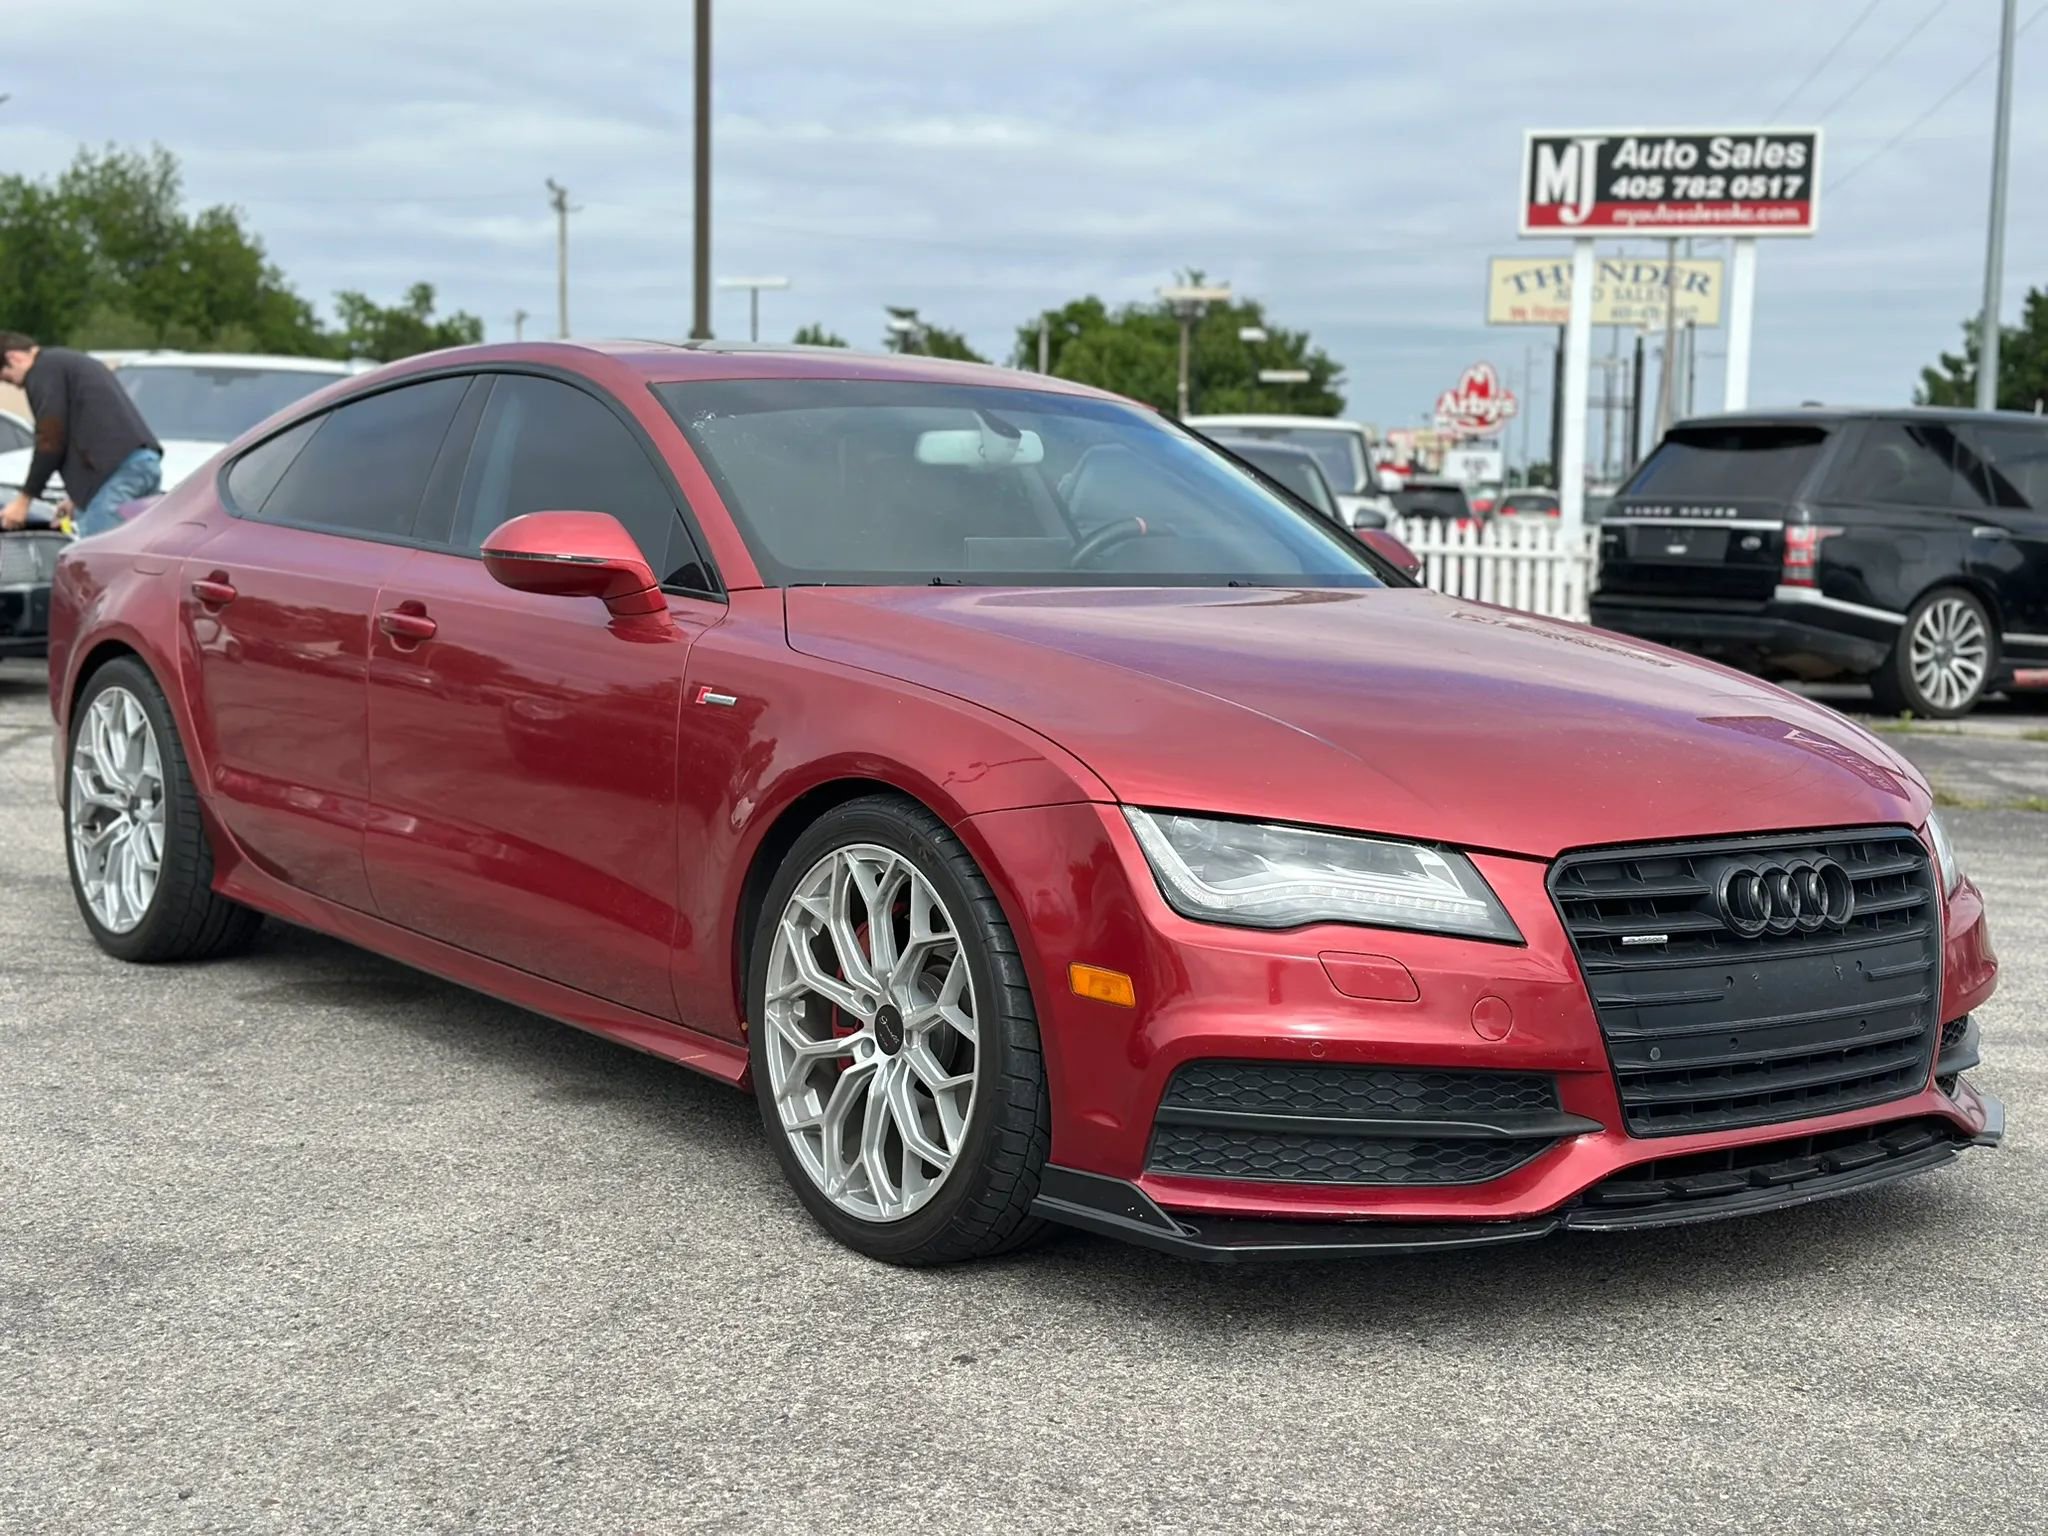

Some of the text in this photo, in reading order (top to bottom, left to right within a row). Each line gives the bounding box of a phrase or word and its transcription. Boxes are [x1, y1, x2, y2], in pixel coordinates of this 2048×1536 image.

[1611, 136, 1806, 169] Auto Sales
[1535, 138, 1607, 224] MJ
[1610, 175, 1803, 198] 405 782 0517
[1502, 262, 1711, 296] THNDER
